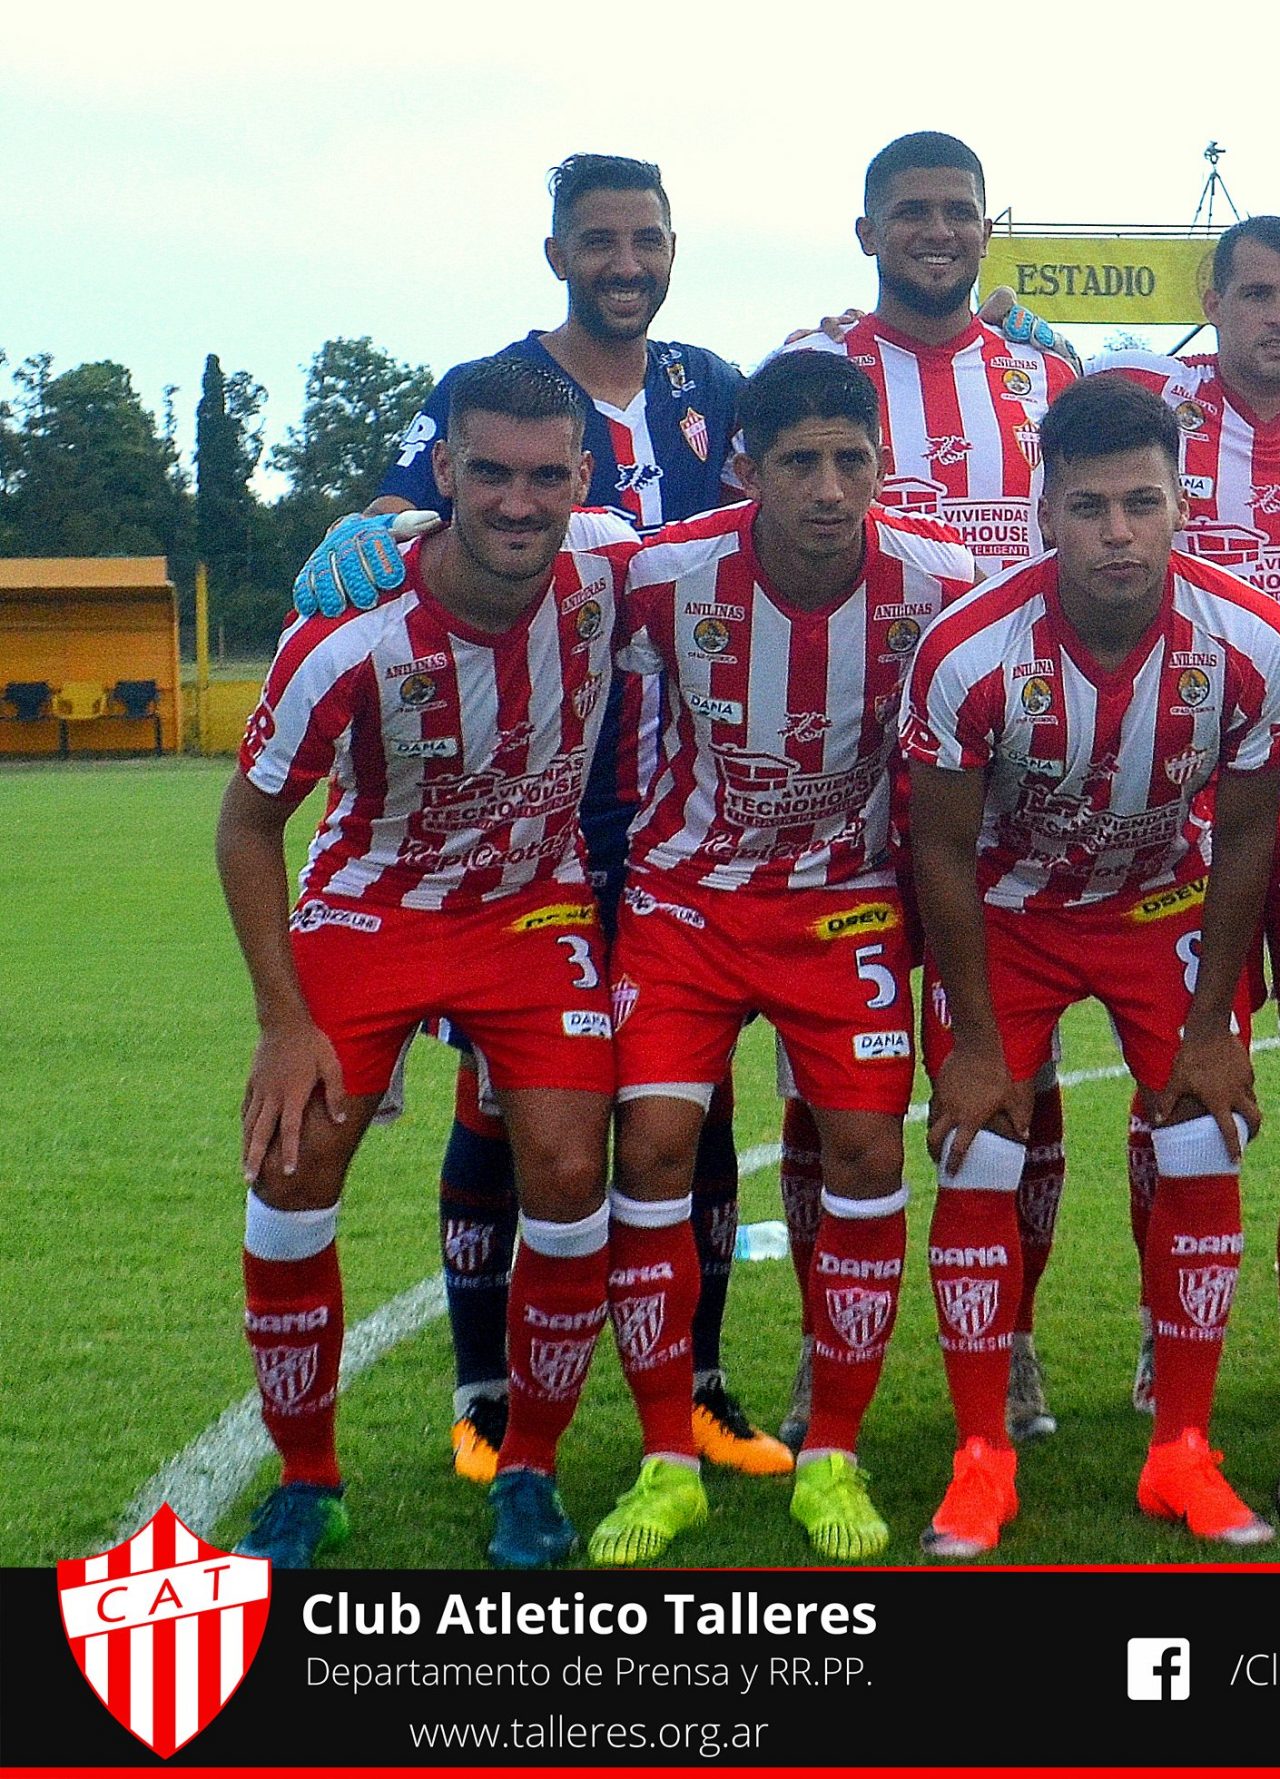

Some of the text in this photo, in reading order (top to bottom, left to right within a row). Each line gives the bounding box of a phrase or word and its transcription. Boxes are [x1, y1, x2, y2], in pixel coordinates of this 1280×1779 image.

[1016, 263, 1155, 297] ESTADIO
[1179, 478, 1205, 490] NA
[943, 509, 1029, 522] VIVIENDAS
[962, 525, 1029, 543] HOUSE
[684, 603, 744, 620] ANILINAS
[874, 603, 933, 620] ANILINAS
[1013, 660, 1055, 679] ANILINA
[689, 694, 734, 716] DANA
[1142, 880, 1207, 916] OSEV
[556, 934, 599, 989] 3
[855, 943, 896, 1008] 5
[860, 1034, 905, 1048] DANA
[816, 1250, 901, 1279] DANA
[930, 1245, 1008, 1268] DANA
